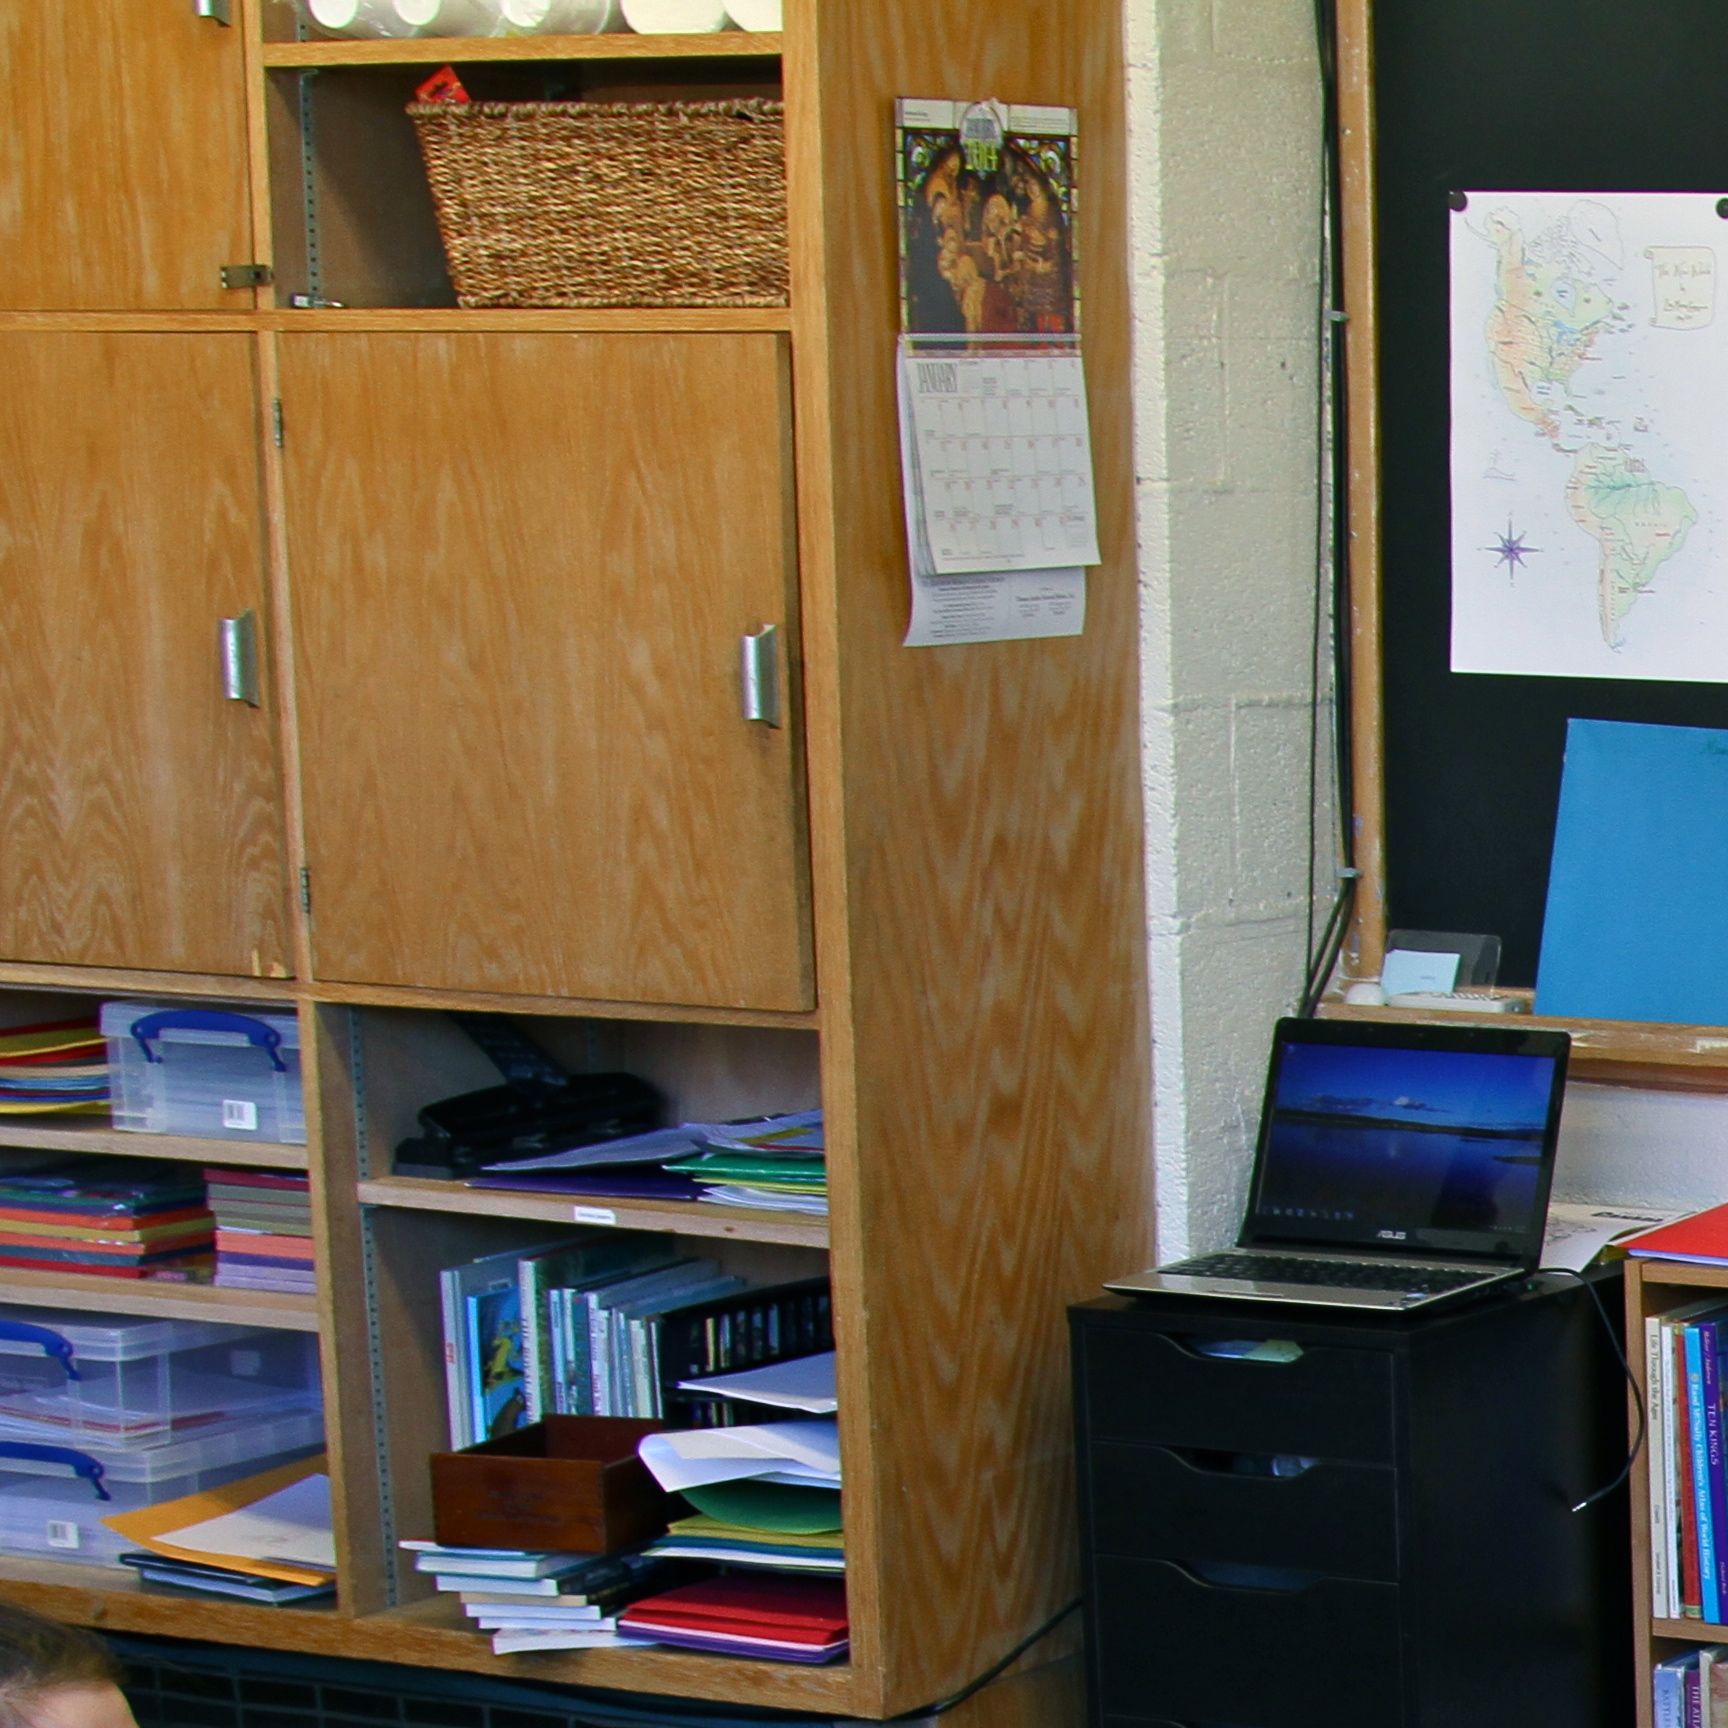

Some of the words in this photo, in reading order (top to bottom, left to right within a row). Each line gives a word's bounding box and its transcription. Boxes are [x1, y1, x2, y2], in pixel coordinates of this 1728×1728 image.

[1378, 1230, 1407, 1240] ASUS
[1650, 1334, 1659, 1350] Life
[1649, 1352, 1660, 1384] Through
[1651, 1386, 1660, 1397] the
[1692, 1384, 1701, 1405] Rand
[1649, 1399, 1660, 1421] Ages
[1707, 1403, 1717, 1427] TEN
[1708, 1429, 1719, 1465] KINGS
[1698, 1489, 1706, 1509] Atlas
[1699, 1511, 1708, 1521] of
[1700, 1523, 1709, 1547] World
[1701, 1549, 1711, 1579] History
[1692, 1685, 1702, 1705] THE
